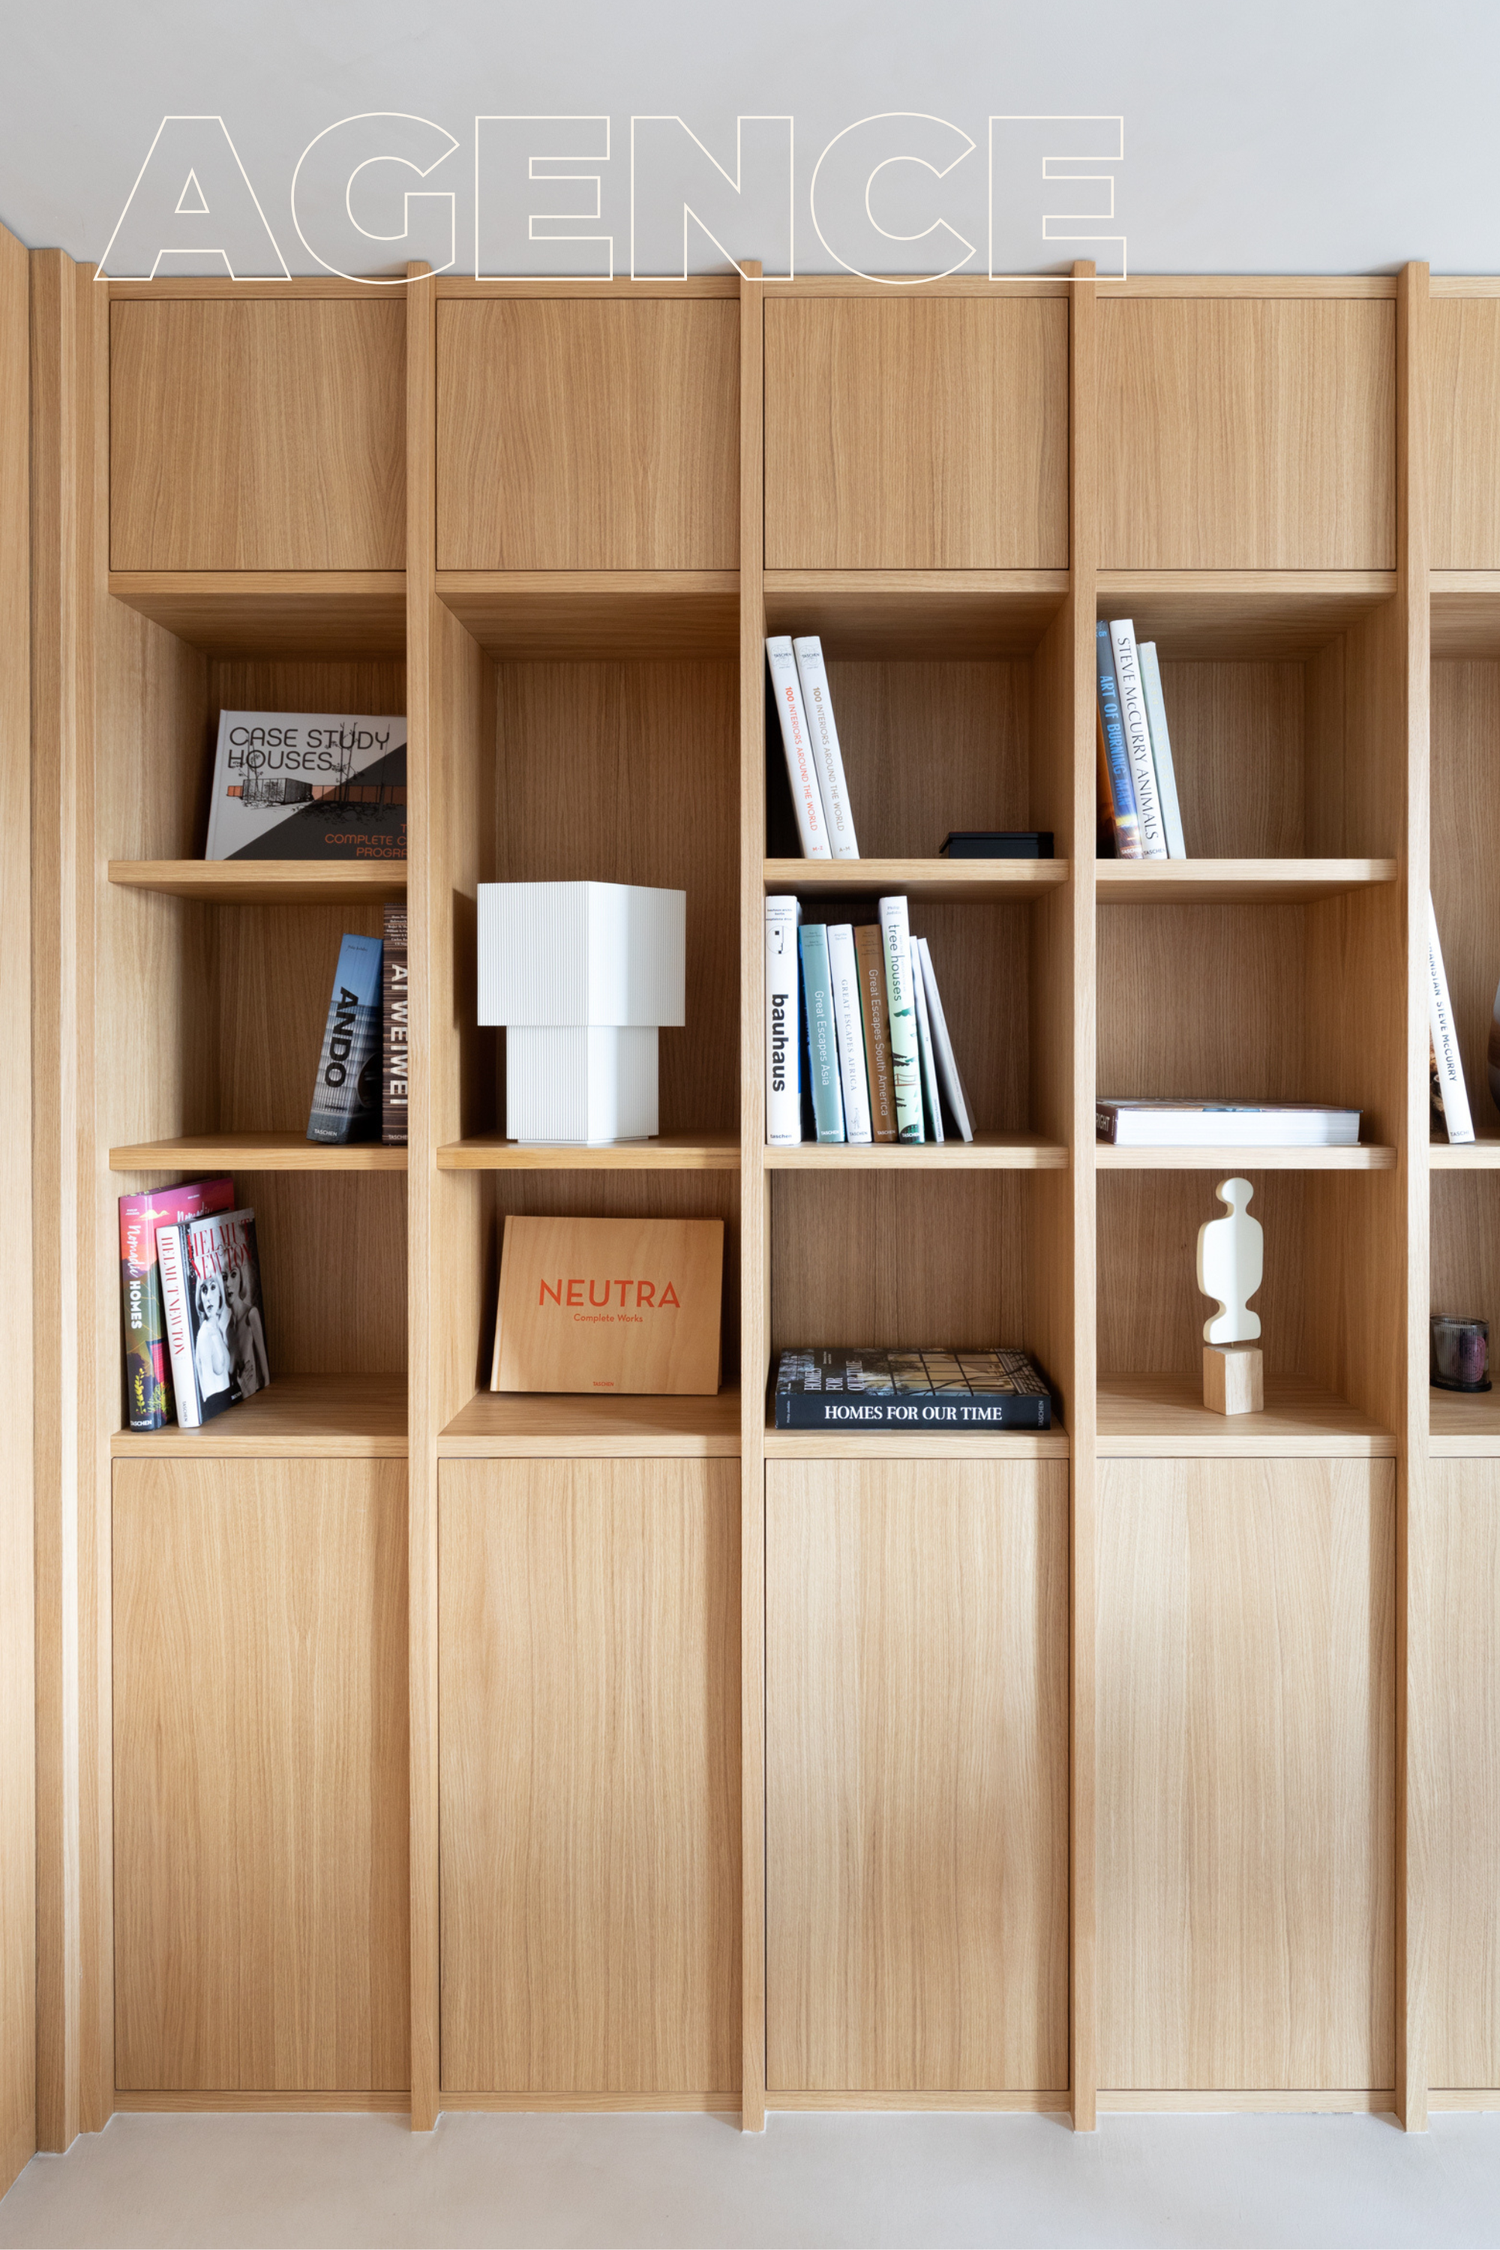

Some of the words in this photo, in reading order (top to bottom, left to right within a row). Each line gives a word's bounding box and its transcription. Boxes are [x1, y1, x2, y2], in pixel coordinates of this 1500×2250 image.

[1117, 637, 1136, 682] STEVE
[785, 685, 795, 703] 100
[812, 686, 822, 703] 100
[1100, 674, 1117, 698] ART
[789, 703, 803, 746] INTERIORS
[816, 704, 830, 746] INTERIORS
[1103, 702, 1119, 719] OF
[1124, 686, 1148, 764] McCURRY
[229, 726, 299, 748] CASE
[306, 728, 390, 751] STUDY
[1106, 721, 1128, 775] BURNING
[227, 749, 333, 771] HOUSES
[796, 747, 809, 783] AROUND
[823, 747, 837, 783] AROUND
[803, 784, 812, 800] THE
[830, 784, 840, 800] THE
[1114, 778, 1131, 807] MAN
[1136, 768, 1159, 841] ANIMALS
[806, 802, 818, 832] WORLD
[833, 802, 845, 832] WORLD
[324, 833, 393, 846] COMPLETE
[888, 924, 900, 952] tree
[391, 963, 408, 990] AI
[868, 969, 880, 997] Great
[890, 954, 905, 1002] houses
[814, 990, 826, 1018] Great
[841, 979, 850, 1009] GREAT
[844, 1012, 854, 1055] ESCAPES
[870, 998, 883, 1042] Escapes
[324, 986, 359, 1088] ANDO
[389, 999, 408, 1105] WEIWEI
[771, 993, 789, 1092] bauhaus
[817, 1018, 828, 1062] Escapes
[1436, 1001, 1449, 1032] STEVE
[1443, 1034, 1457, 1083] McCURRY
[874, 1042, 887, 1071] South
[820, 1063, 830, 1086] Asia
[847, 1055, 858, 1092] AFRICA
[878, 1072, 889, 1117] America
[314, 1128, 338, 1137] TASCHEN
[126, 1224, 146, 1279] Nomadic
[186, 1217, 251, 1259] HELMUT
[160, 1236, 180, 1299] HELMUT
[190, 1242, 252, 1281] NEWTON
[129, 1280, 143, 1330] HOMES
[538, 1278, 681, 1309] NEUTRA
[168, 1297, 186, 1356] NEWTON
[573, 1313, 615, 1323] Complete
[617, 1314, 644, 1323] Works
[803, 1367, 822, 1391] HOMES
[846, 1359, 864, 1376] TIME
[825, 1377, 844, 1391] FOR
[129, 1419, 153, 1427] TASCHEN
[824, 1405, 883, 1420] HOMES
[886, 1406, 918, 1420] FOR
[922, 1406, 958, 1421] OUR
[960, 1406, 1003, 1421] TIME
